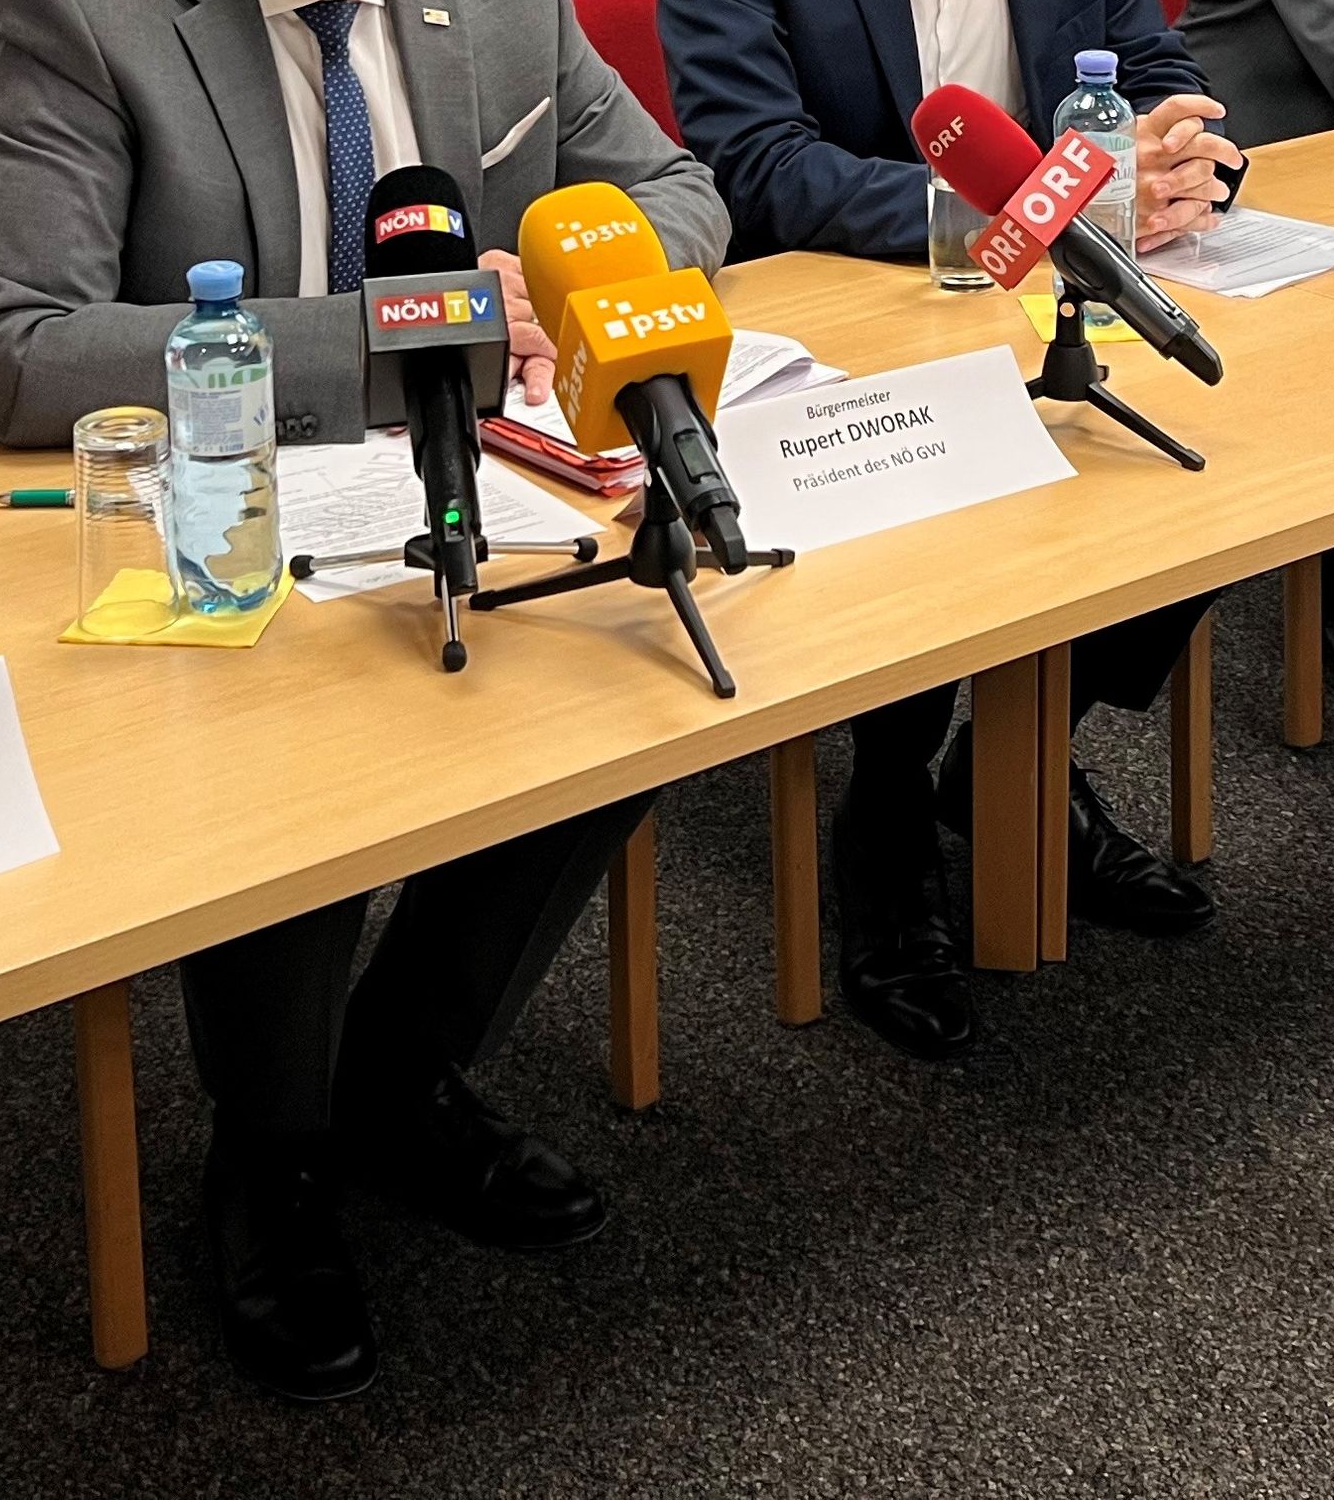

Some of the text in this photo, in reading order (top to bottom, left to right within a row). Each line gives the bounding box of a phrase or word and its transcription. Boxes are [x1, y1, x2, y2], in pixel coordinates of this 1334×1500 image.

[928, 115, 966, 158] ORF
[1023, 137, 1091, 224] ORF
[581, 219, 639, 248] p3tv
[981, 219, 1027, 275] ORF
[631, 303, 706, 339] p3tv
[806, 390, 891, 419] Bürgermeister
[780, 406, 935, 458] Rupert DWORAK
[792, 441, 947, 492] Präsident des NÖ GVV
